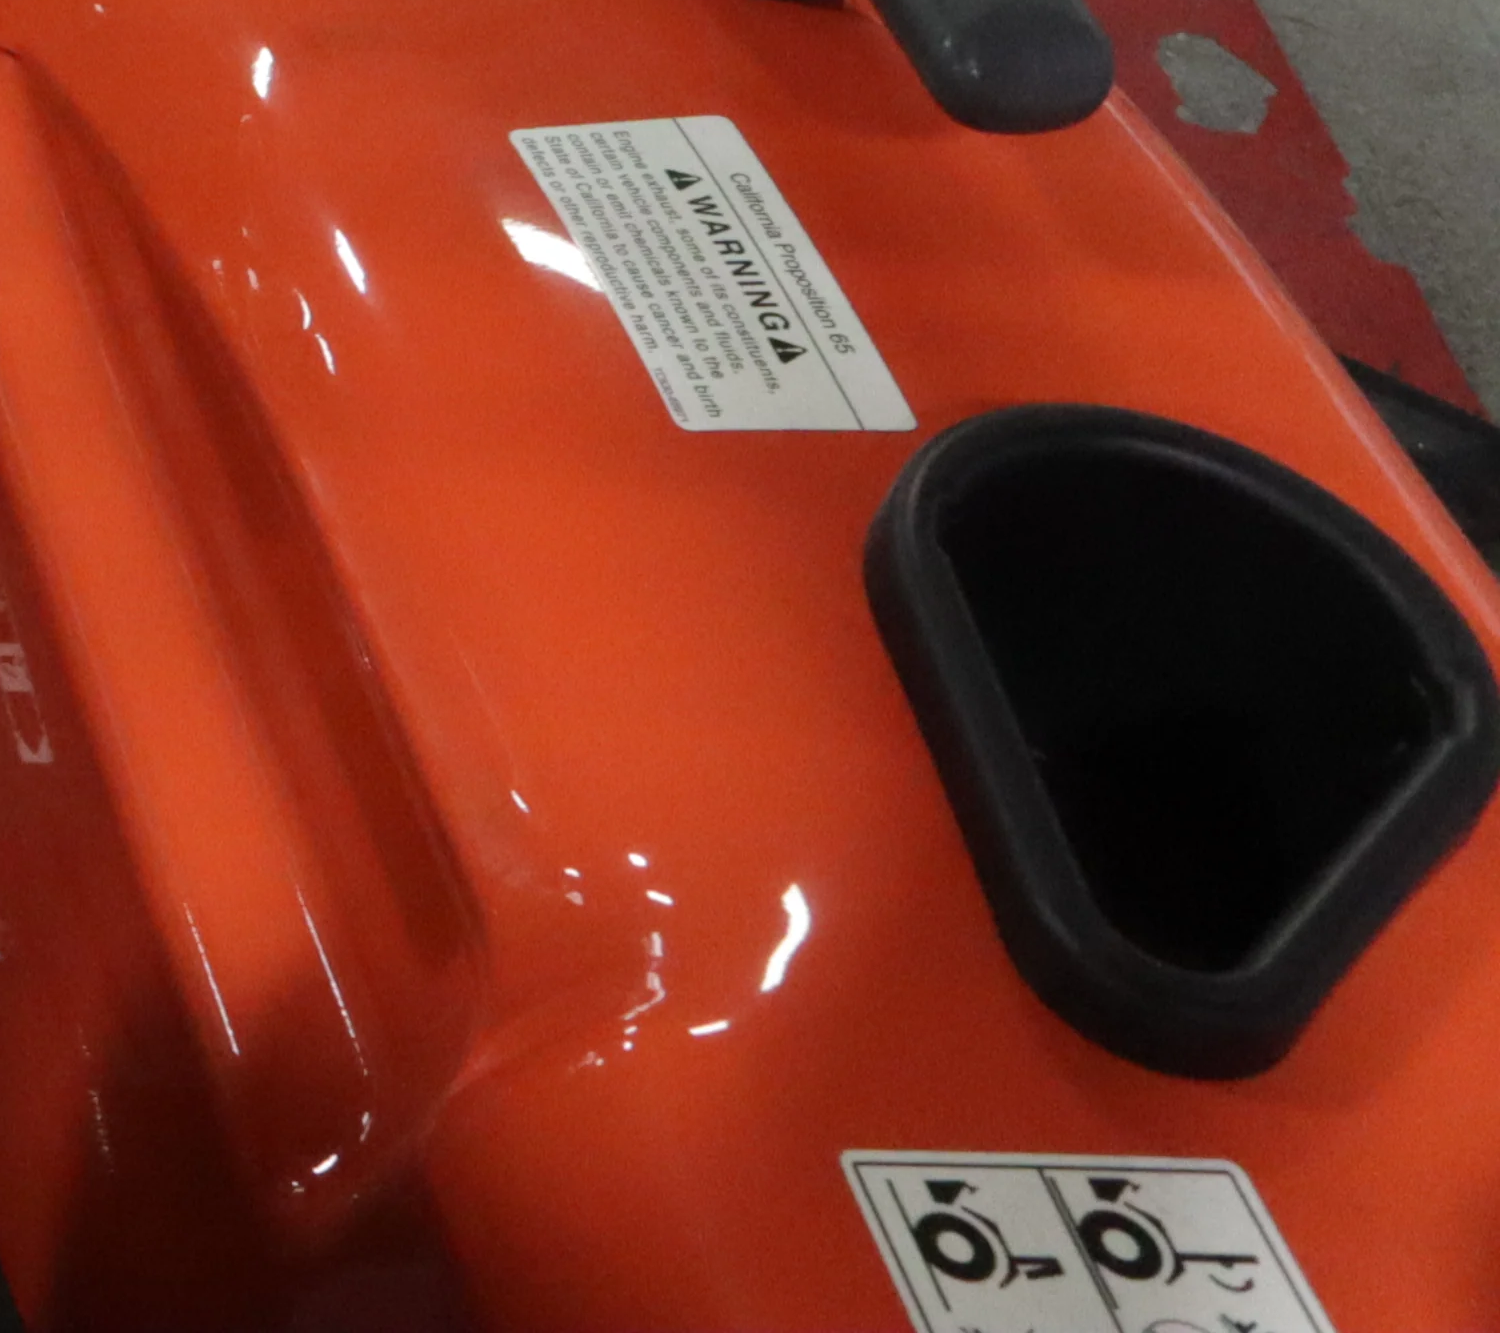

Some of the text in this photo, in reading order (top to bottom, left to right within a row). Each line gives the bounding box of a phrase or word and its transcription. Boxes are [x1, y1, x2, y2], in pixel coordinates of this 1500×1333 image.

[521, 137, 658, 349] defects or other reproductive harm.
[543, 135, 570, 164] State
[564, 167, 584, 178] of
[575, 182, 618, 239] California
[612, 243, 629, 255] to
[622, 259, 653, 297] cause
[647, 302, 683, 348] cancer
[675, 354, 703, 379] and
[693, 385, 721, 417] birth
[566, 133, 724, 378] contain or emit chemicals known to the
[589, 131, 623, 169] certain
[618, 173, 652, 215] vehicle
[646, 219, 702, 297] components
[695, 301, 721, 325] and
[612, 130, 647, 168] Engine
[676, 228, 705, 261] some
[710, 283, 728, 299] its
[722, 304, 780, 394] constituents,
[689, 195, 789, 330] WARNING
[729, 172, 855, 353] California Proposition 65
